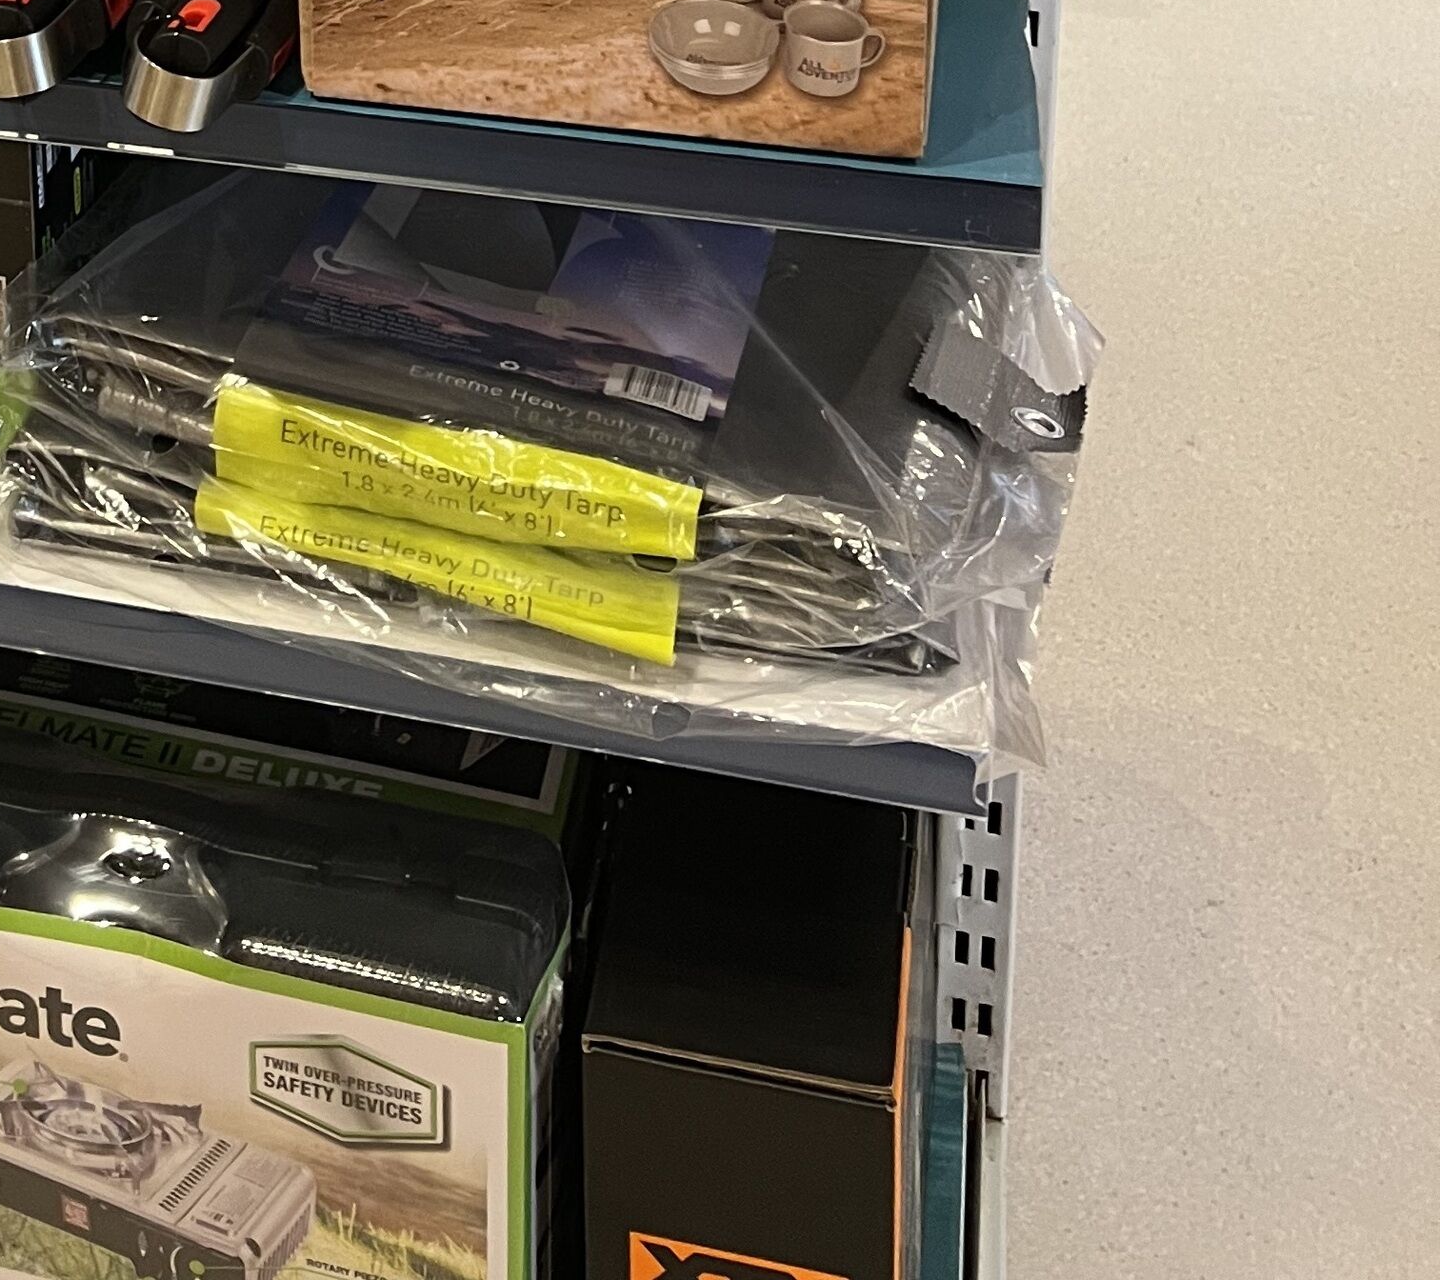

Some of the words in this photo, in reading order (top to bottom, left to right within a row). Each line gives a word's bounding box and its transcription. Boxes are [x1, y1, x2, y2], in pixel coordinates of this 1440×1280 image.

[409, 364, 503, 398] Extreme
[511, 386, 580, 419] Heavy
[281, 418, 391, 470] Extreme
[400, 454, 481, 495] Heavy
[489, 473, 553, 509] Duty
[564, 489, 625, 528] Tarp
[341, 470, 373, 492] 1.8
[260, 515, 370, 554] Extreme
[381, 537, 462, 573] Heavy
[548, 576, 604, 608] Tarp
[263, 1055, 299, 1074] TWIN
[303, 1064, 422, 1104] OVER-PRESSURE
[263, 1072, 335, 1102] SAFETY
[341, 1091, 422, 1125] DEVICES
[306, 1258, 351, 1278] ROTARY
